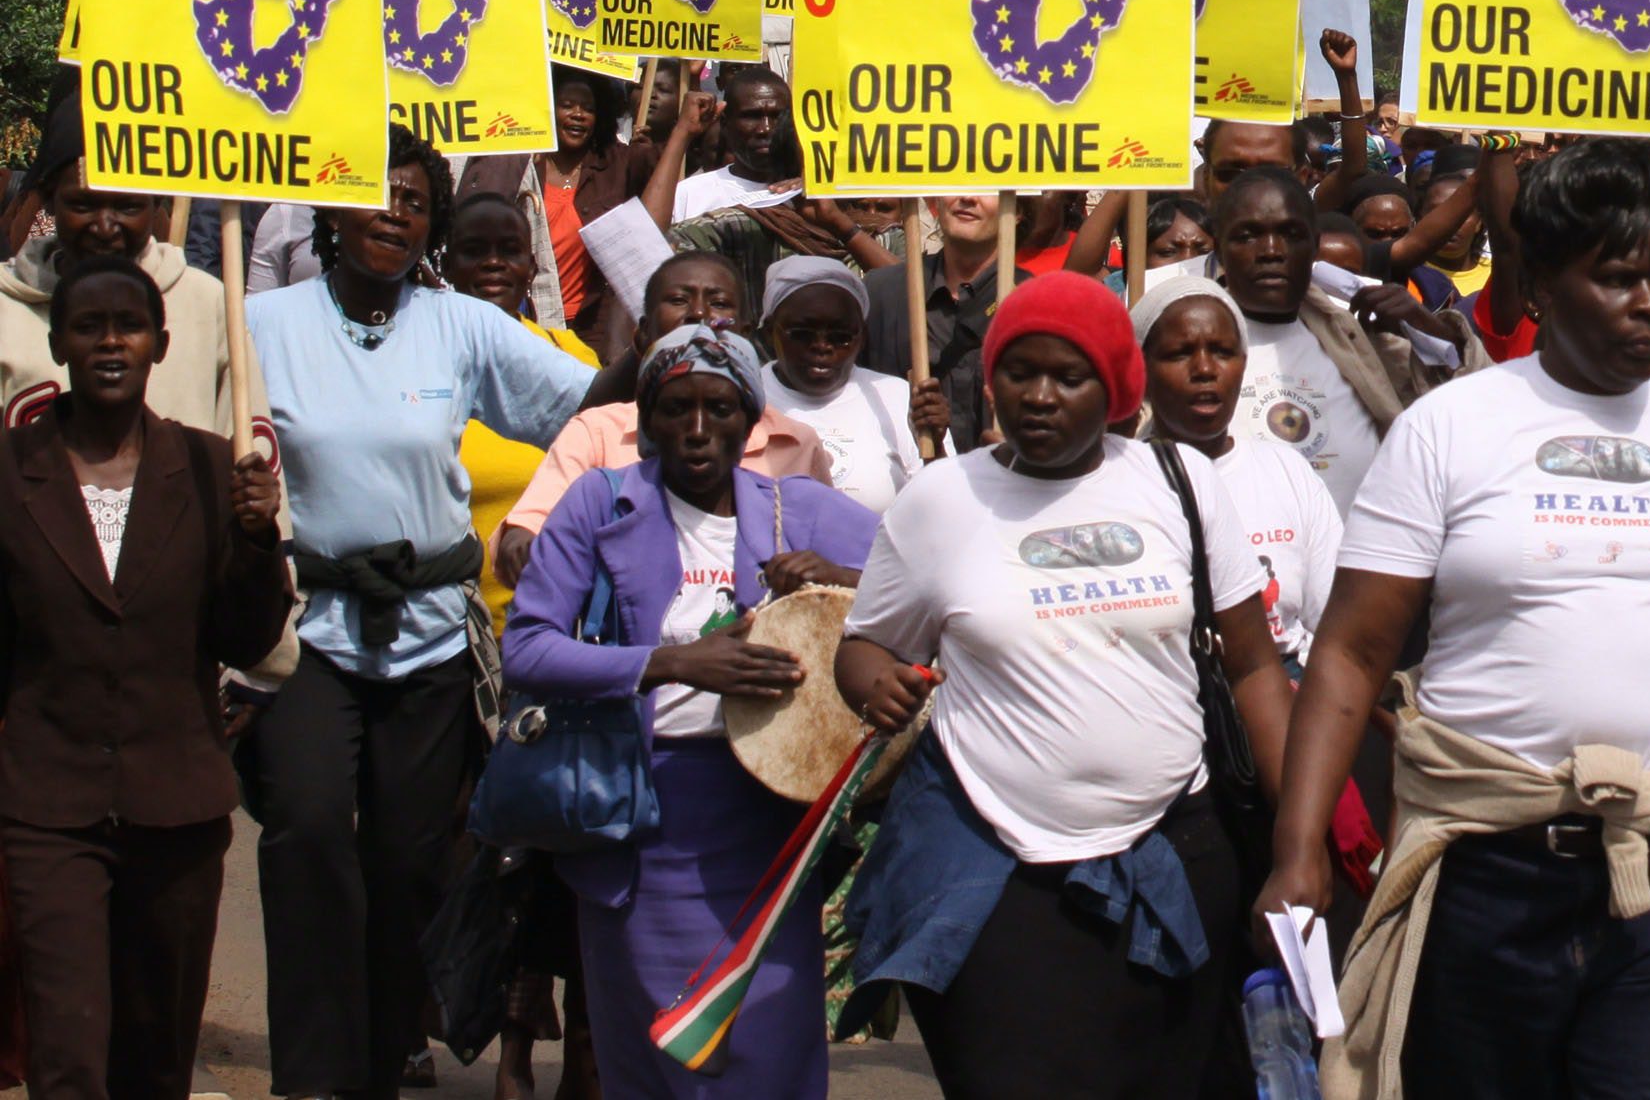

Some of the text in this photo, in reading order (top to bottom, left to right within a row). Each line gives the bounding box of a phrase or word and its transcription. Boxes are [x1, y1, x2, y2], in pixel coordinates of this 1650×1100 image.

[602, 19, 720, 52] MEDICINE
[1431, 3, 1530, 56] OUR
[92, 60, 183, 116] OUR
[850, 63, 951, 114] OUR
[96, 122, 312, 187] MEDICINE
[849, 123, 1100, 174] MEDICINE
[1267, 529, 1295, 543] LEO
[1534, 514, 1550, 523] IS
[1553, 514, 1587, 526] NOT
[1029, 574, 1173, 605] HEALTH
[1034, 595, 1181, 620] IS NOT COMMERCE
